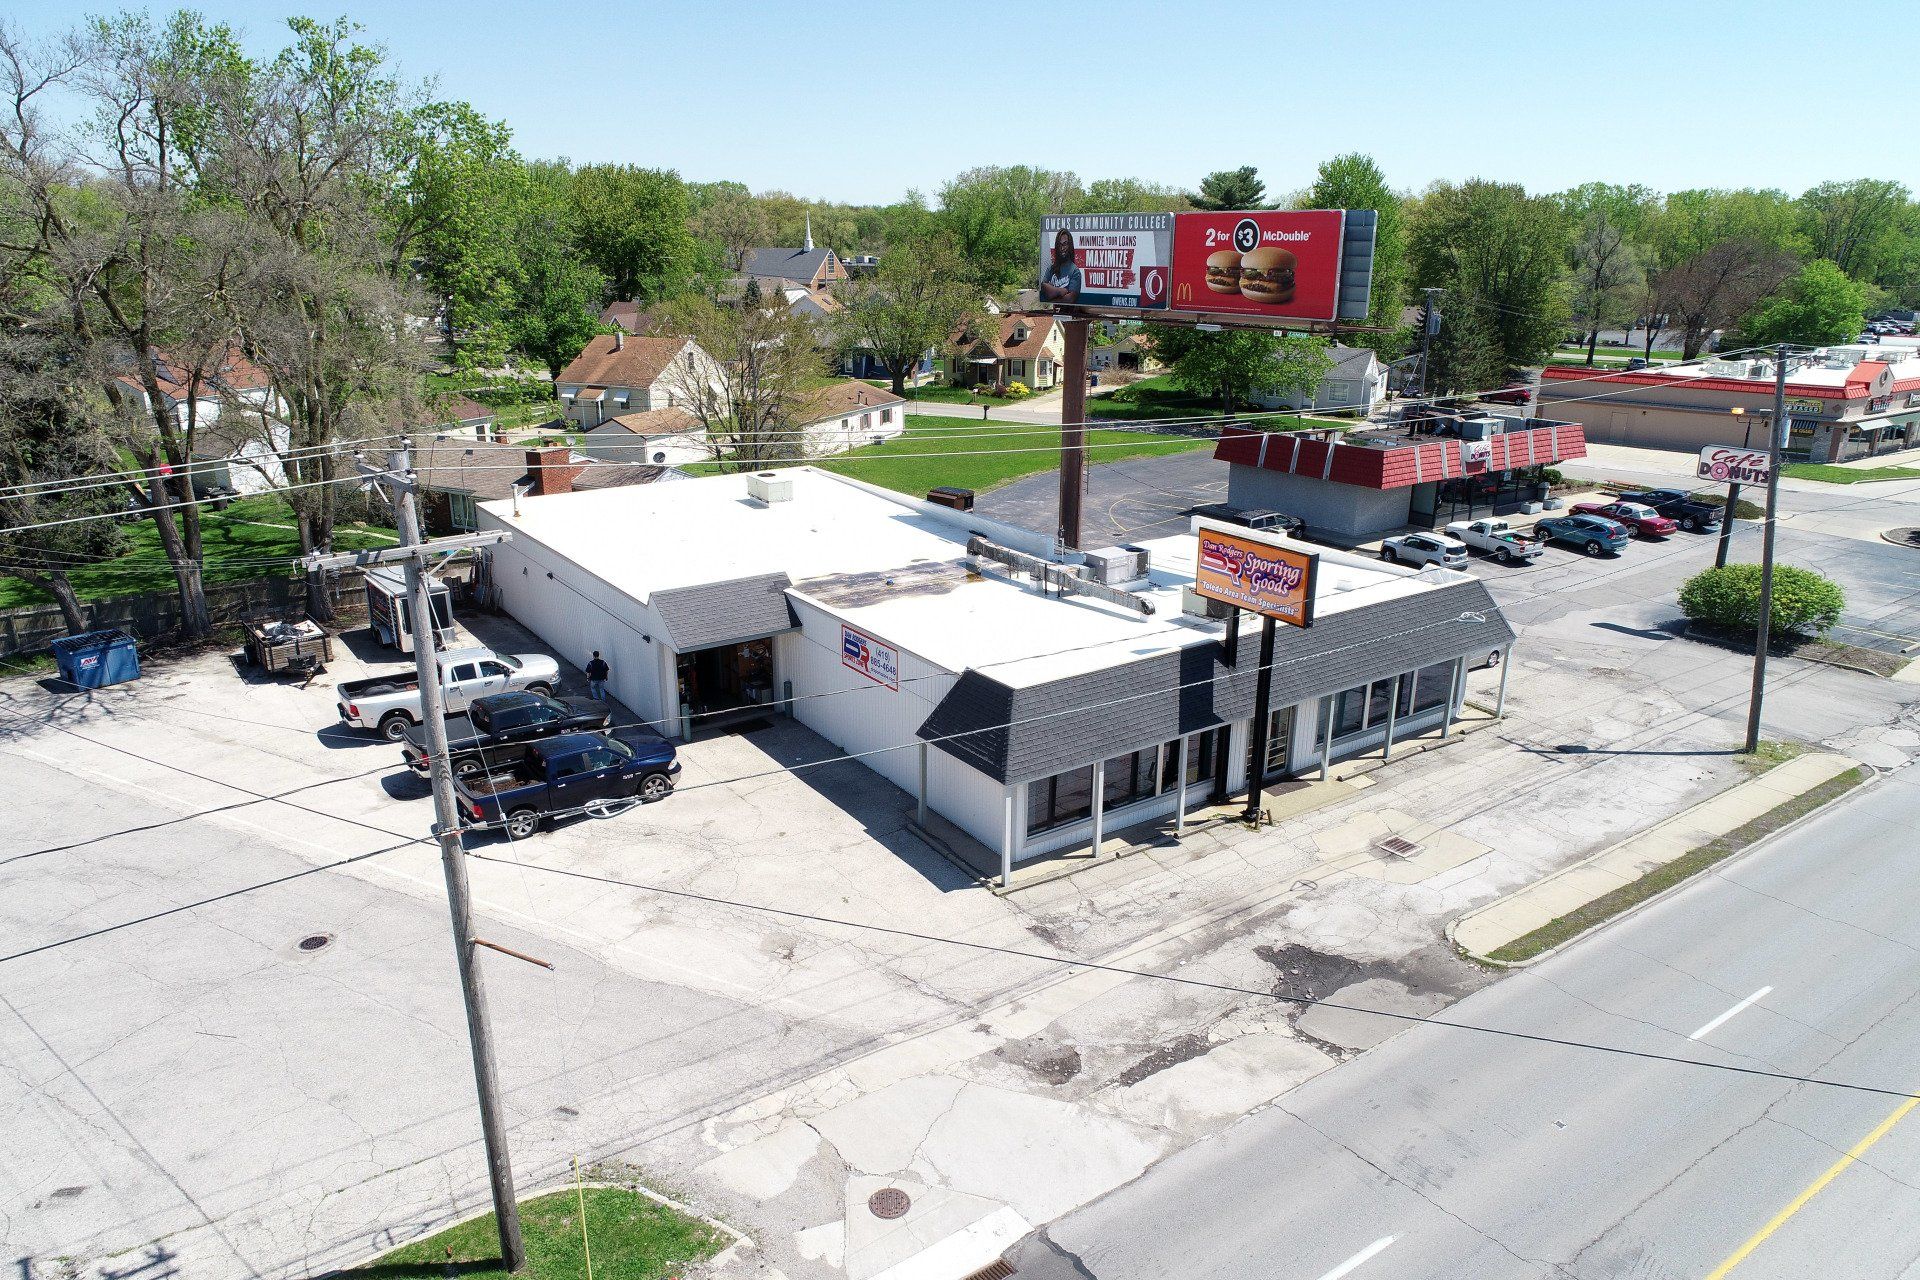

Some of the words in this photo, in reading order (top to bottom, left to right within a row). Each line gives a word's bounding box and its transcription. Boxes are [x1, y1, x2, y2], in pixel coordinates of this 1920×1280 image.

[1045, 217, 1071, 230] OWENS
[1075, 216, 1124, 230] COMMUNITY
[1128, 215, 1166, 229] COLLEGE
[1079, 235, 1104, 247] MINIMIZE
[1105, 236, 1117, 246] YOUR
[1118, 235, 1137, 247] LOANS
[1205, 228, 1216, 247] 2
[1217, 230, 1230, 241] for
[1237, 228, 1254, 247] $3
[1085, 249, 1128, 268] MAXIMIZE
[1089, 272, 1105, 286] YOUR
[1106, 270, 1124, 288] LIFE
[1111, 296, 1138, 307] OWENS.EDU
[1711, 449, 1766, 468] Café
[1203, 540, 1217, 550] Dan
[1218, 544, 1244, 559] Rodgers
[1244, 553, 1300, 585] Sporting
[1250, 573, 1289, 594] Goods
[1223, 587, 1239, 599] Area
[1240, 592, 1258, 604] Team
